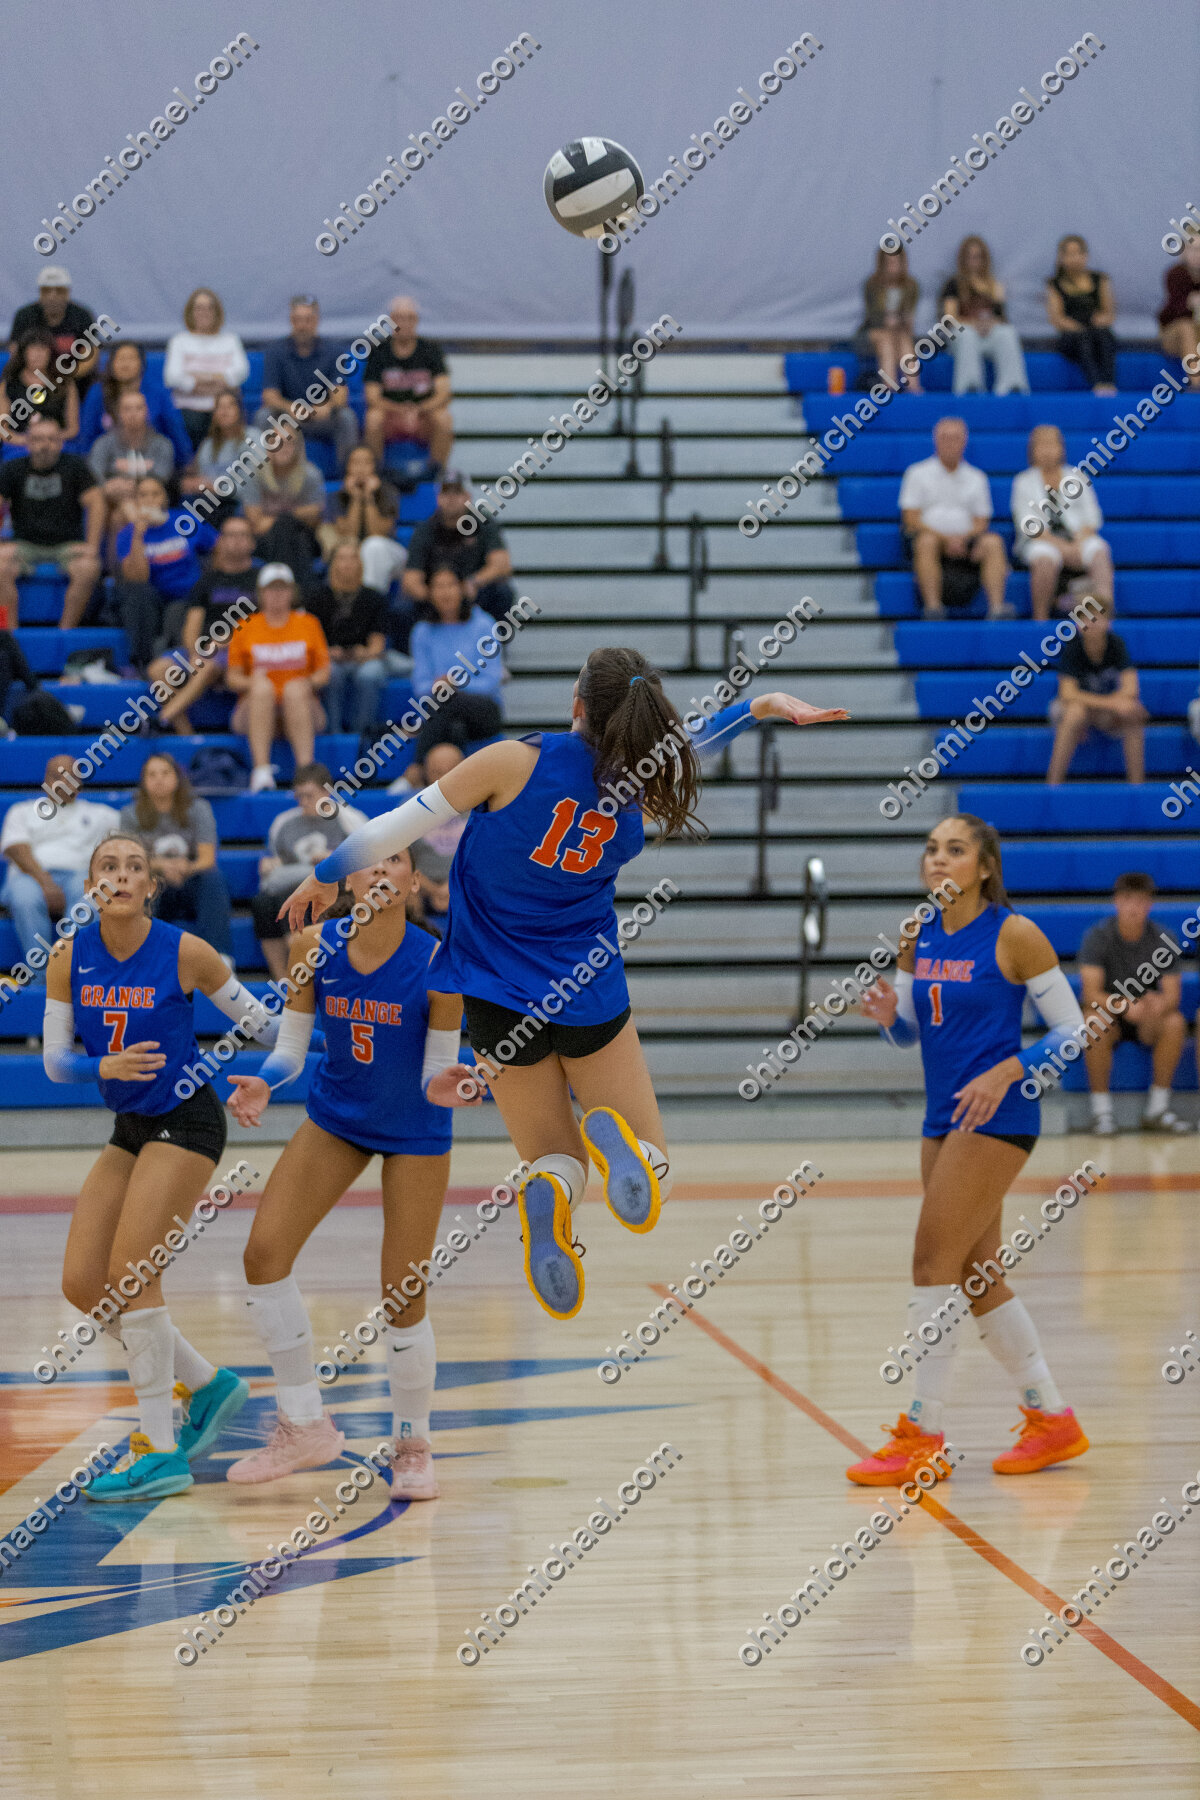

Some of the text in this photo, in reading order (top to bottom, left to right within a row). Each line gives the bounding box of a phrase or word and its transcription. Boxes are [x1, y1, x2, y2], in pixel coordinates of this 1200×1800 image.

[529, 797, 618, 874] 13
[81, 985, 156, 1009] ORANGE
[325, 995, 403, 1026] ORANGE
[928, 983, 944, 1026] 1
[103, 1010, 128, 1054] 7
[350, 1022, 374, 1064] 5
